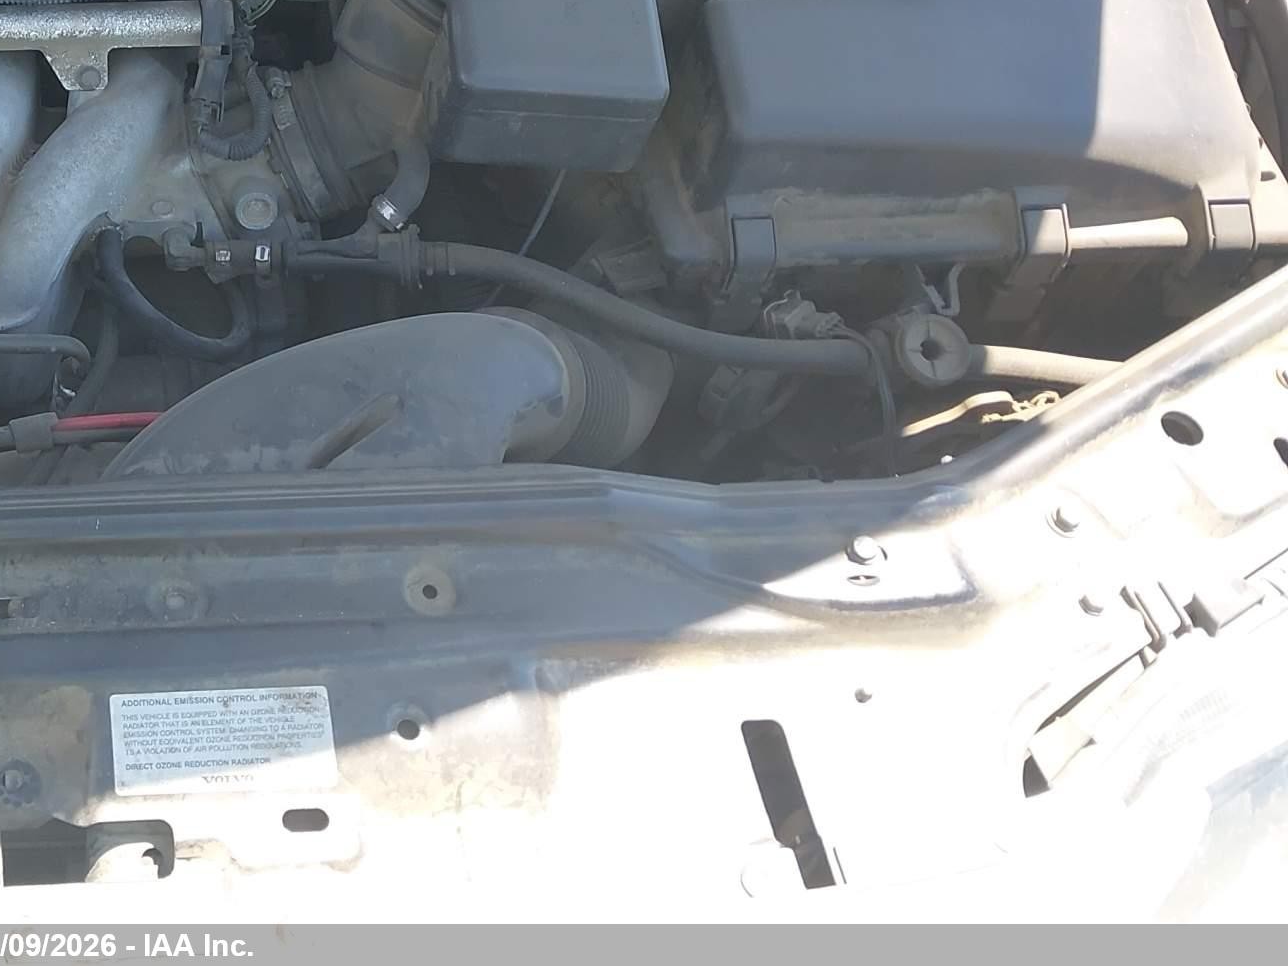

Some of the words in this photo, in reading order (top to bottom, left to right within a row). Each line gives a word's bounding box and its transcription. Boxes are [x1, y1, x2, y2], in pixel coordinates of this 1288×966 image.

[122, 697, 172, 707] ADDITIONAL
[174, 696, 214, 705] EMISSION
[217, 694, 257, 703] CONTROL
[259, 691, 317, 701] INFORMATION
[181, 711, 217, 719] EQUIPPED
[123, 722, 159, 730] RADIATOR
[202, 718, 234, 726] ELEMENT
[124, 730, 158, 738] EMISSION
[160, 729, 194, 737] CONTROL
[288, 723, 324, 731] RADIATOR
[125, 739, 156, 747] WITHOUT
[159, 736, 203, 745] EQUIVALENT
[206, 735, 231, 743] OZONE
[144, 747, 181, 755] VIOLATION
[208, 743, 248, 752] POLLUTION
[126, 762, 153, 771] DIRECT
[156, 761, 182, 769] OZONE
[185, 759, 229, 768] REDUCTION
[232, 757, 271, 765] RADIATOR
[202, 775, 253, 783] VOLVO
